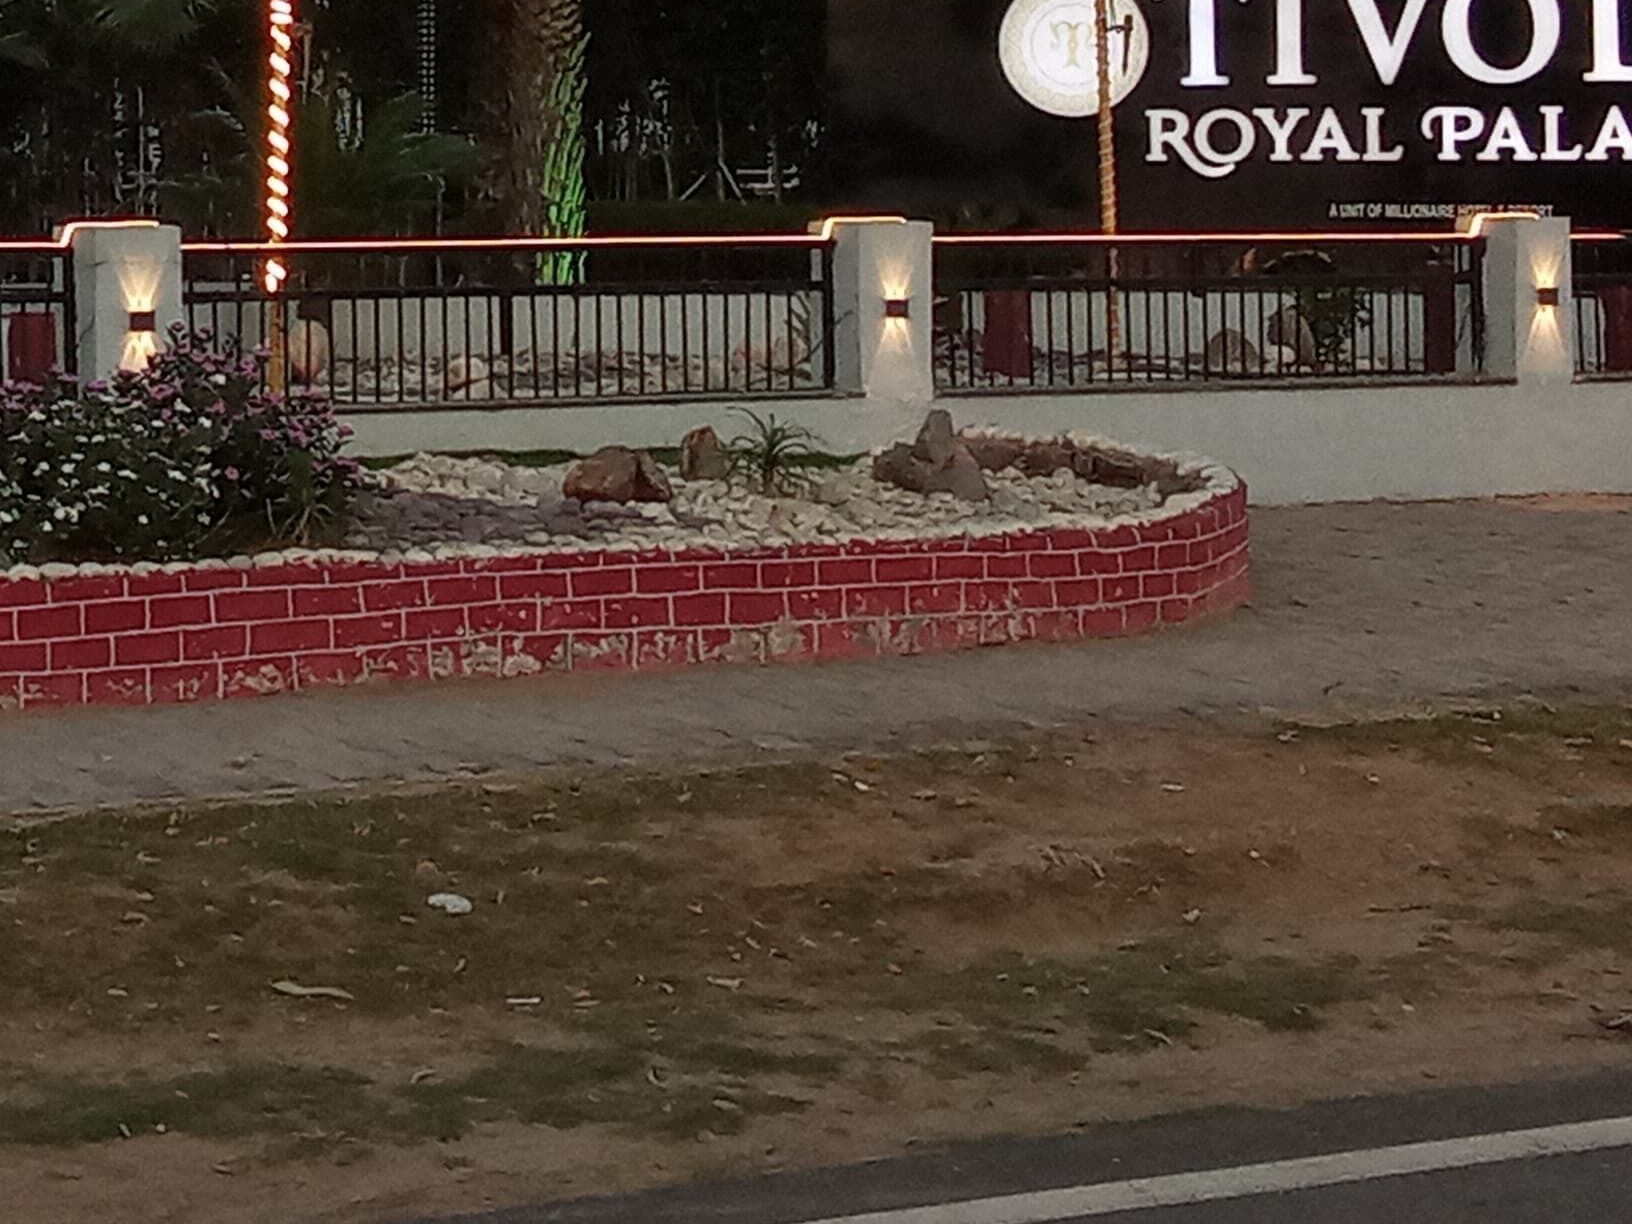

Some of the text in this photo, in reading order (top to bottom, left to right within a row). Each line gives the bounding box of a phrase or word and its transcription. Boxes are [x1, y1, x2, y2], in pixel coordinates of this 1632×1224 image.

[1143, 107, 1404, 178] ROYAL
[1328, 202, 1339, 218] A
[1366, 203, 1384, 218] OF
